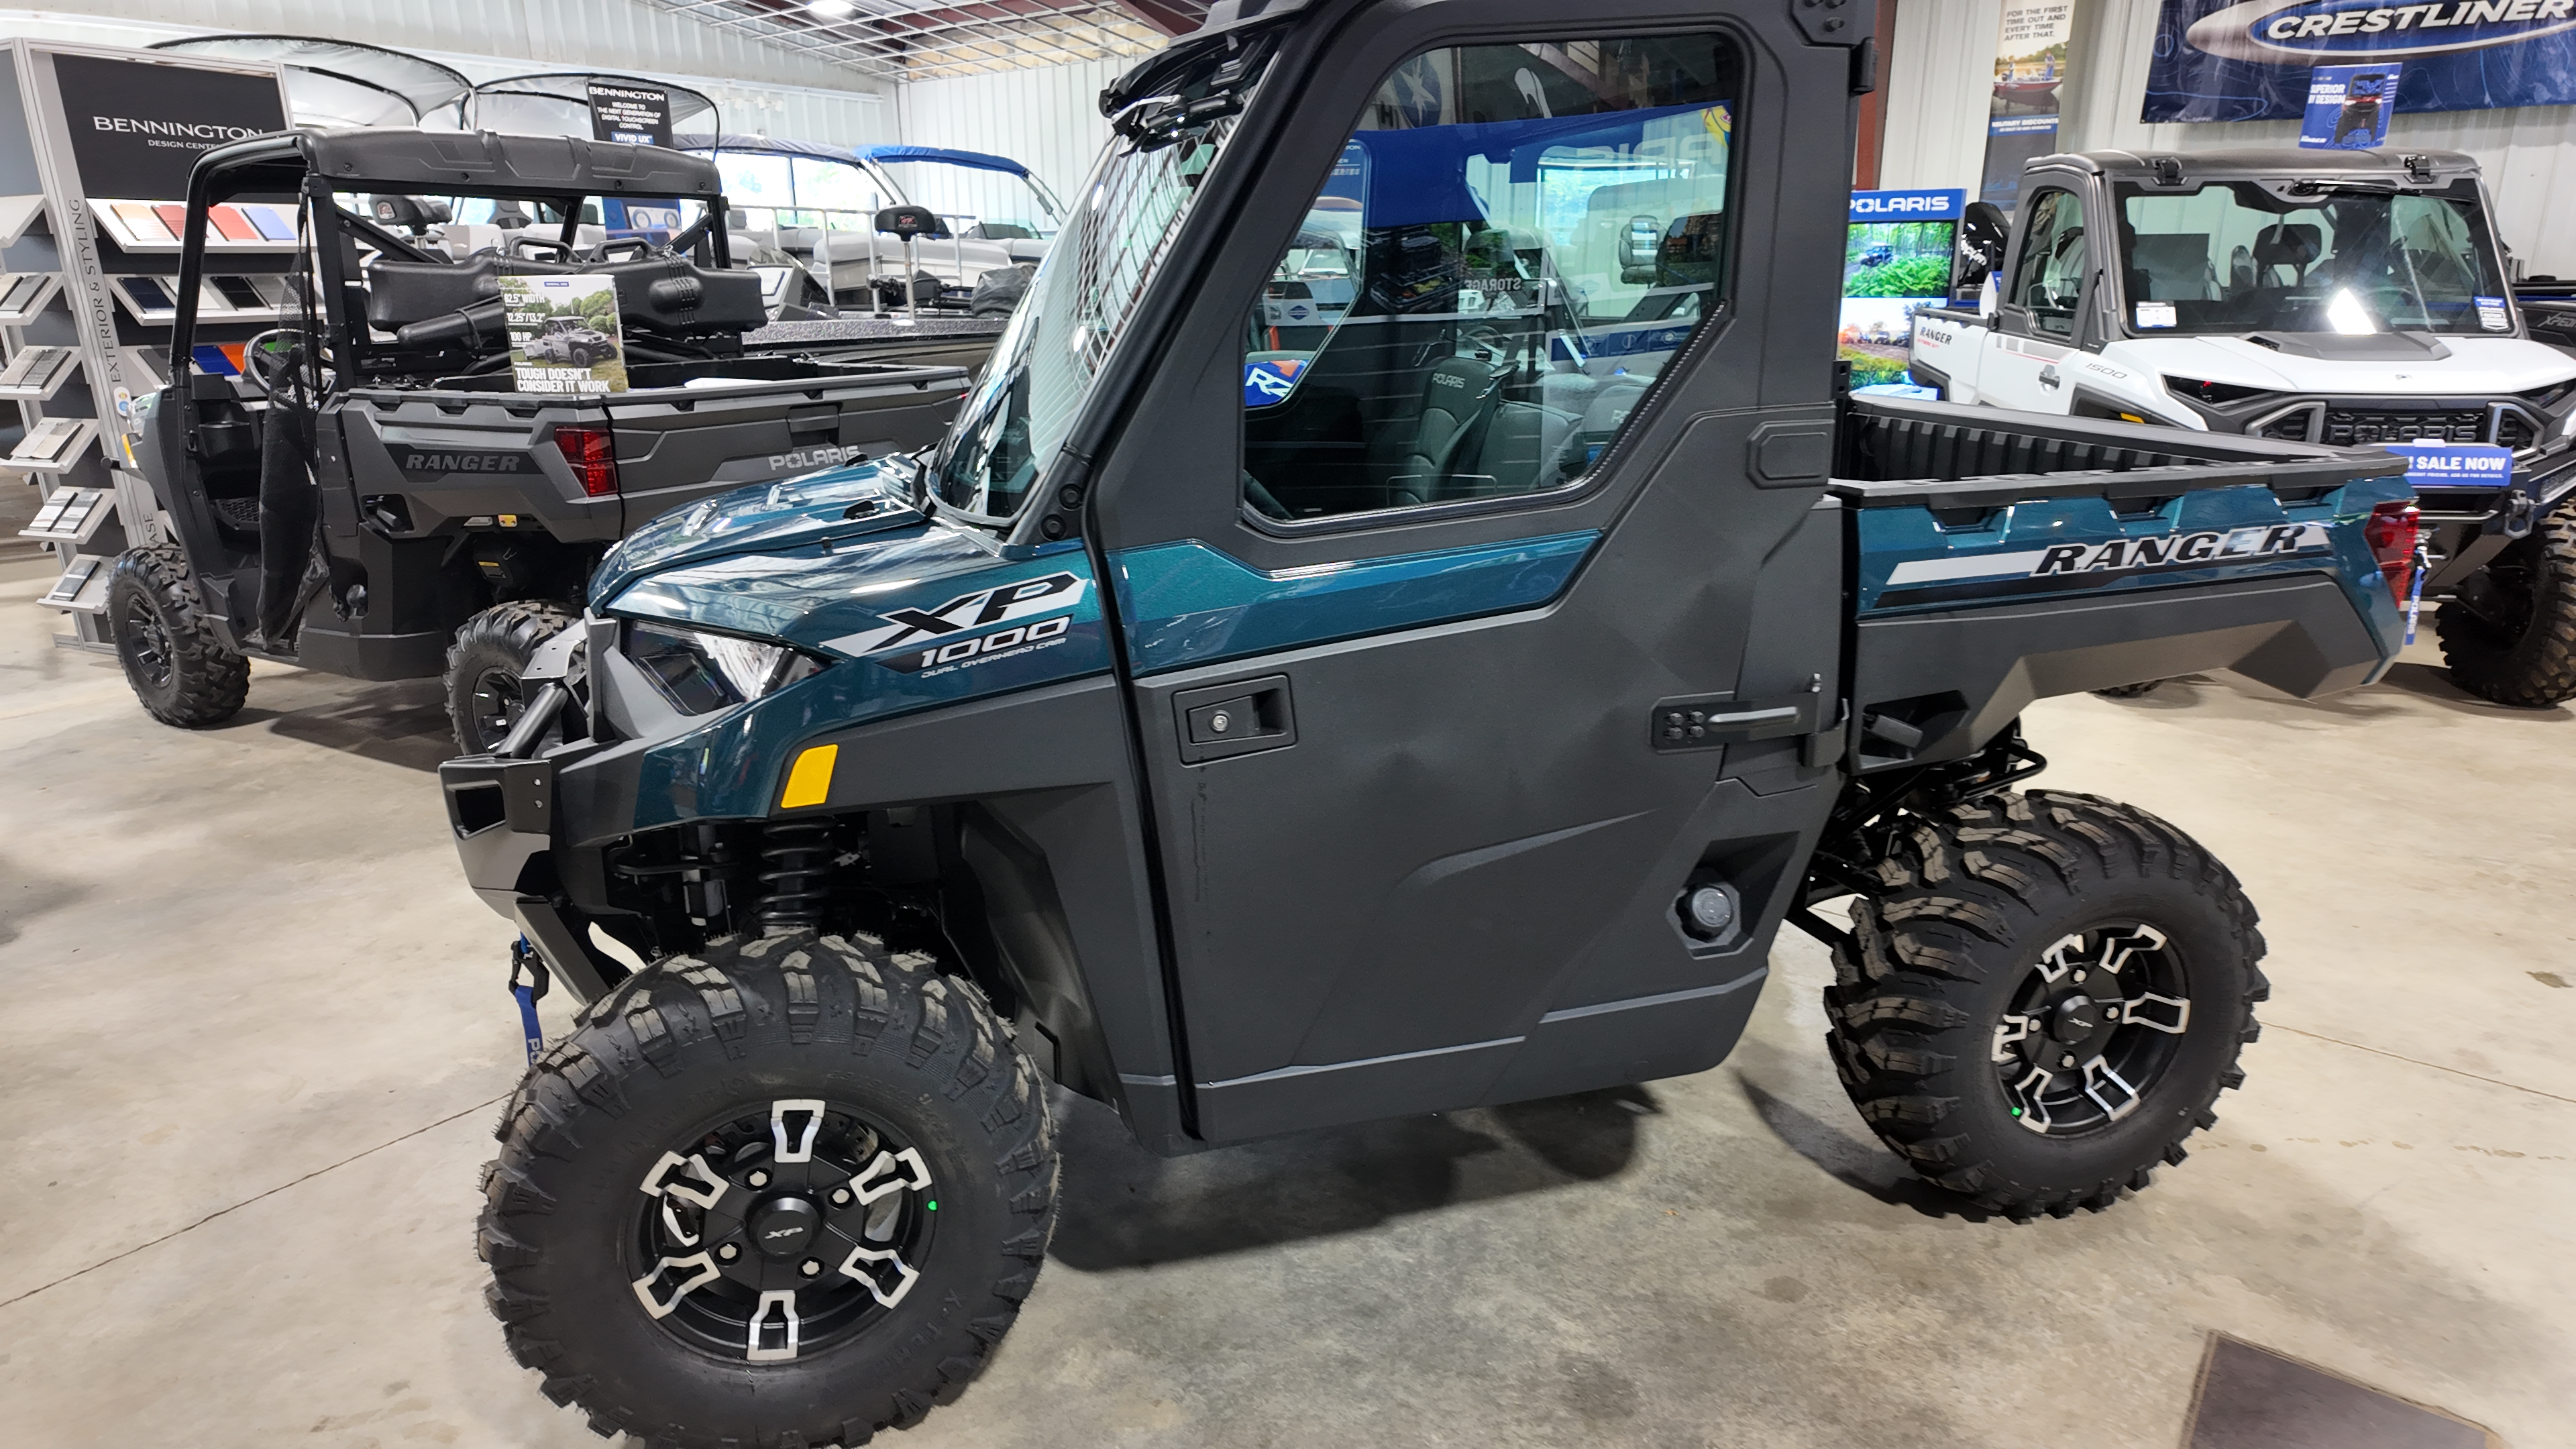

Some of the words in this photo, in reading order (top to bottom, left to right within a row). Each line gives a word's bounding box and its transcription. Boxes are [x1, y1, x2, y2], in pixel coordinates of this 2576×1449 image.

[2043, 5, 2068, 13] FIRST
[2047, 13, 2066, 21] AND
[2267, 0, 2575, 40] CRESTLINER
[2004, 25, 2031, 33] EVERY
[2004, 33, 2030, 41] AFTER
[588, 86, 665, 101] BENNINGTON
[2310, 84, 2346, 94] SUPERIOR
[2316, 94, 2347, 104] DESIGN
[93, 116, 263, 140] BENNINGTON
[147, 139, 184, 149] DESIGN
[185, 142, 220, 150] CENTE
[614, 133, 637, 142] VIVID
[68, 199, 97, 276] STYLING
[89, 281, 101, 292] &
[521, 293, 545, 304] WIDTH
[2537, 312, 2576, 328] XPEDI
[93, 298, 121, 382] EXTERIOR
[509, 331, 521, 341] 100
[523, 331, 533, 341] HP
[1919, 326, 1952, 345] RANGER
[515, 368, 547, 380] TOUGH
[547, 368, 592, 380] DOESN'T
[2086, 363, 2127, 379] 1500
[517, 380, 564, 392] CONSIDER
[565, 380, 576, 392] IT
[577, 380, 611, 392] WORK
[1432, 373, 1466, 388] POLARIS
[2329, 425, 2478, 443] POLARIS
[406, 454, 521, 471] RANGER
[768, 445, 860, 471] POLARIS
[2416, 456, 2463, 470] SALE
[2465, 457, 2506, 471] NOW
[2030, 525, 2308, 576] RANGER
[861, 572, 1079, 653] XP
[920, 616, 1071, 669] 1000
[921, 665, 959, 679] DUAL
[961, 645, 1035, 669] OVERHEAD
[1035, 637, 1067, 650] CAM
[764, 1226, 804, 1240] XP
